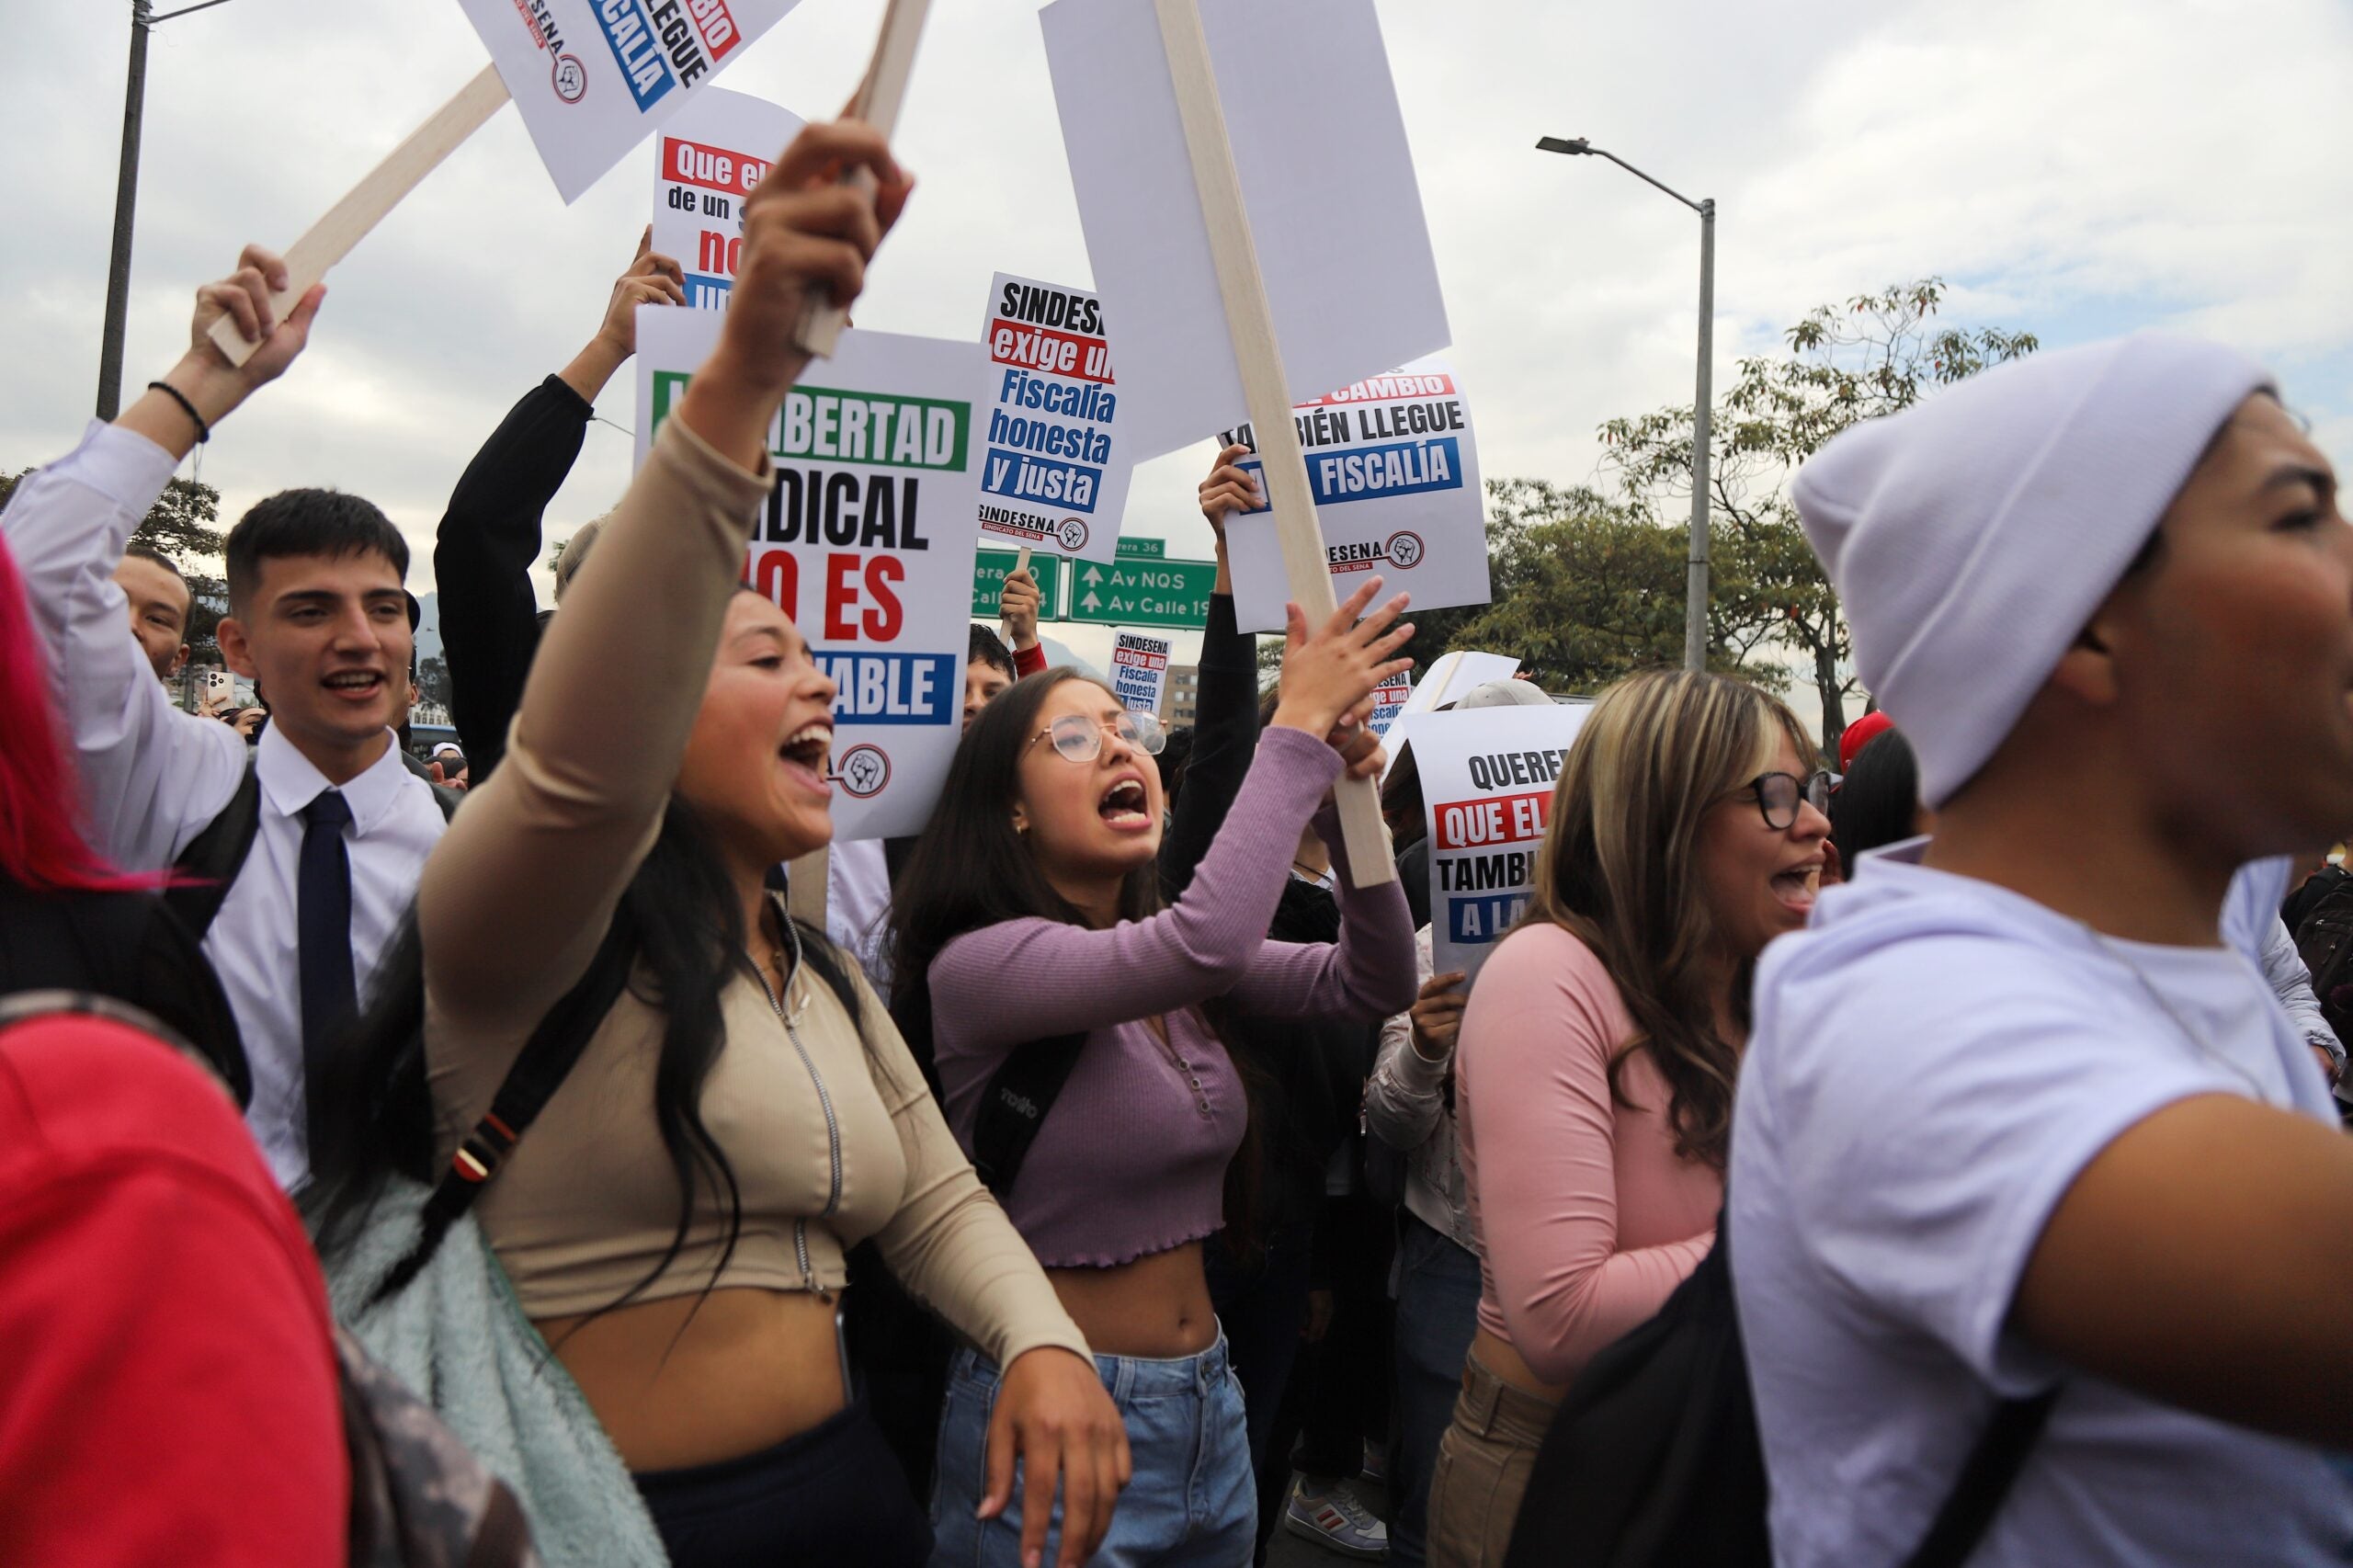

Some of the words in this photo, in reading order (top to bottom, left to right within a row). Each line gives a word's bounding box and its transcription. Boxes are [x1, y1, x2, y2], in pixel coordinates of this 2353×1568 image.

[527, 0, 564, 55] SENA
[597, 0, 665, 97] CALÍA
[676, 143, 733, 186] Que
[741, 162, 767, 192] el
[668, 186, 696, 212] de
[703, 194, 730, 220] un
[993, 327, 1078, 372] exige
[1084, 346, 1116, 380] un
[1000, 369, 1117, 424] Fiscalía
[767, 392, 957, 467] IBERTAD
[987, 408, 1112, 465] honesta
[1358, 401, 1466, 440] LLEGUE
[987, 457, 1011, 493] y
[1014, 456, 1094, 506] justa
[1319, 440, 1450, 496] FISCALÍA
[751, 467, 929, 551] DICAL
[978, 504, 1054, 533] SINDESENA
[983, 523, 1014, 535] SINDICATO
[1026, 532, 1040, 540] SENA
[1142, 542, 1158, 552] 36
[1324, 541, 1383, 562] ESENA
[976, 567, 1005, 579] era
[1109, 570, 1137, 586] Av
[1142, 572, 1186, 590] NQS
[741, 549, 799, 627] O
[824, 552, 905, 643] ES
[972, 588, 1003, 604] Call
[1108, 596, 1135, 612] Av
[1140, 597, 1188, 615] Calle
[1116, 650, 1147, 667] exige
[1148, 655, 1165, 670] una
[1119, 634, 1168, 655] SINDESENA
[814, 656, 936, 716] ABLE
[1115, 679, 1156, 699] honesta
[1119, 665, 1158, 684] Fiscalía
[1389, 688, 1408, 703] una
[1444, 801, 1506, 847] QUE
[1512, 797, 1546, 838] EL
[1436, 850, 1540, 892] TAMBI
[1461, 903, 1483, 937] A
